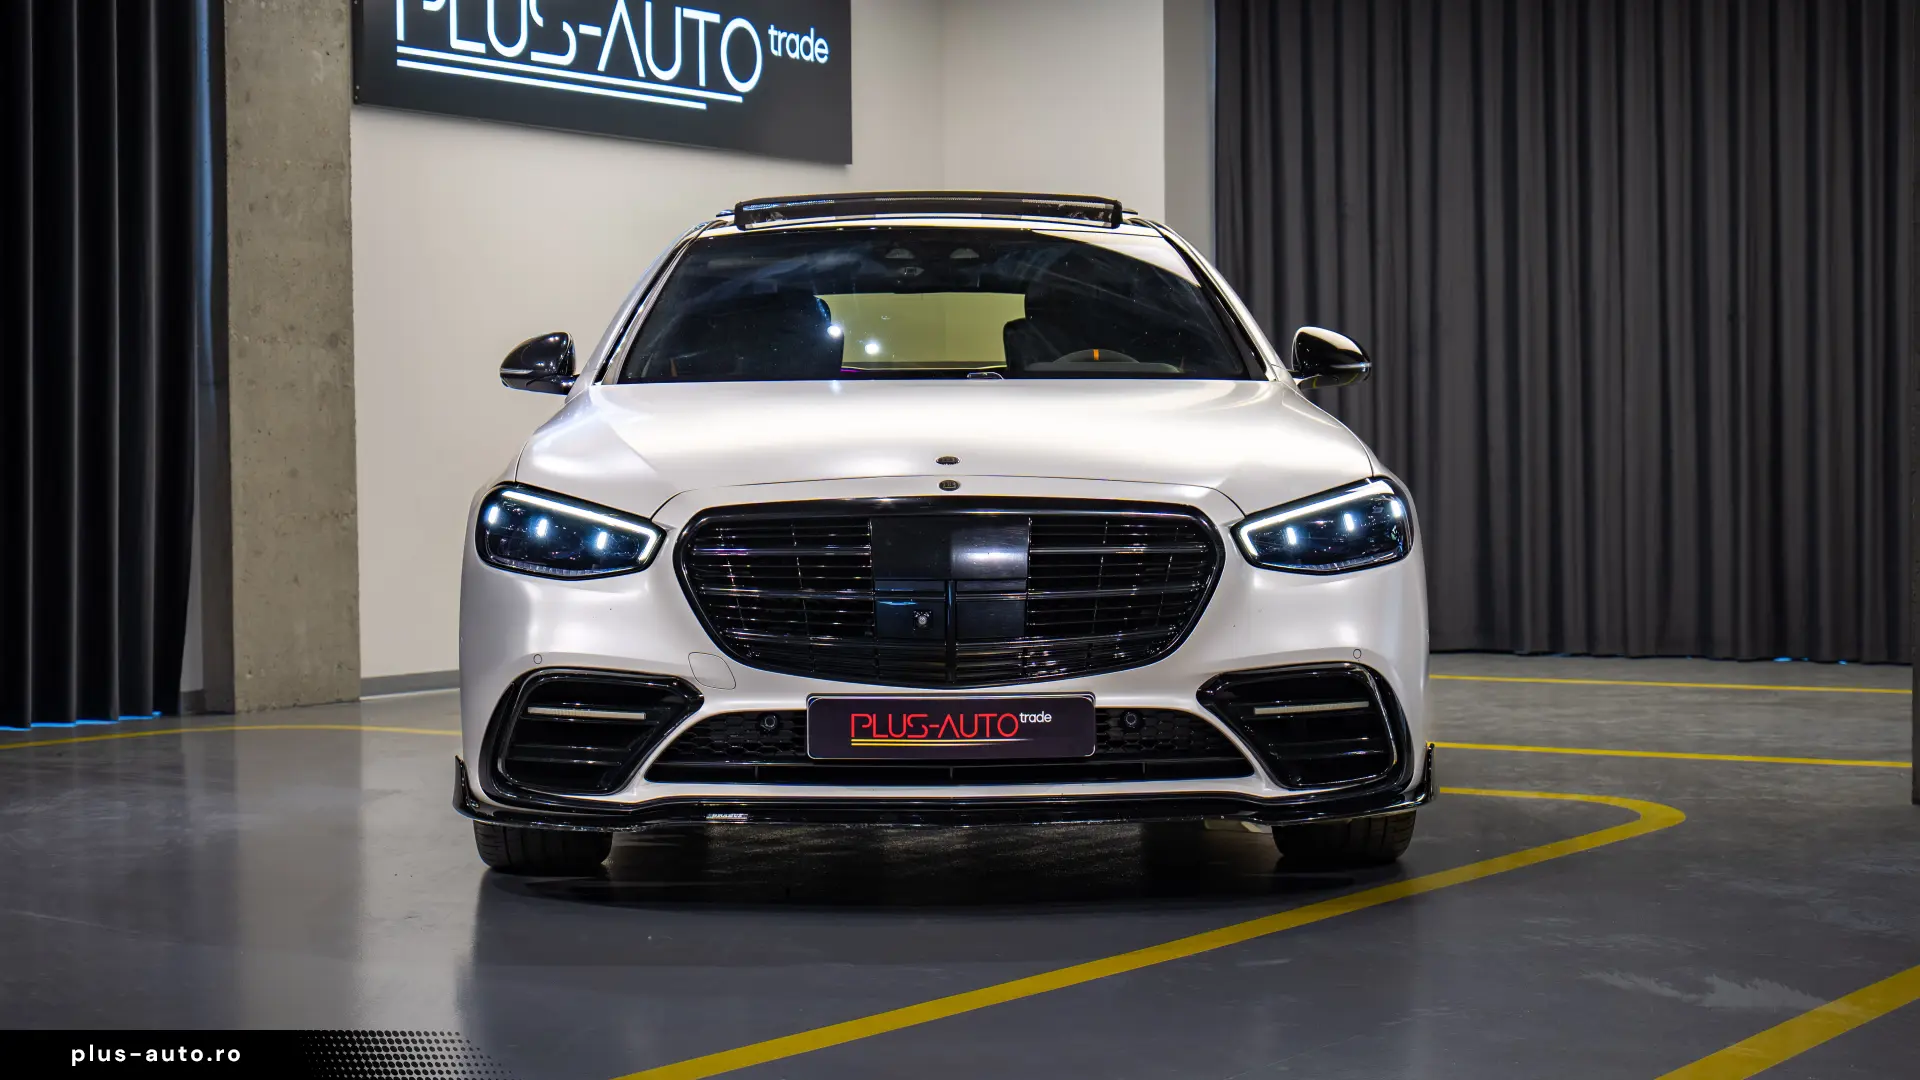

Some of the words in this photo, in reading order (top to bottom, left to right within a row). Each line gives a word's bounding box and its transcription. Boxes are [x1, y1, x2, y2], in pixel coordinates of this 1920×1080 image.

[768, 24, 829, 64] trade
[851, 713, 1018, 738] PLUS-AUTO
[1019, 711, 1052, 723] trade
